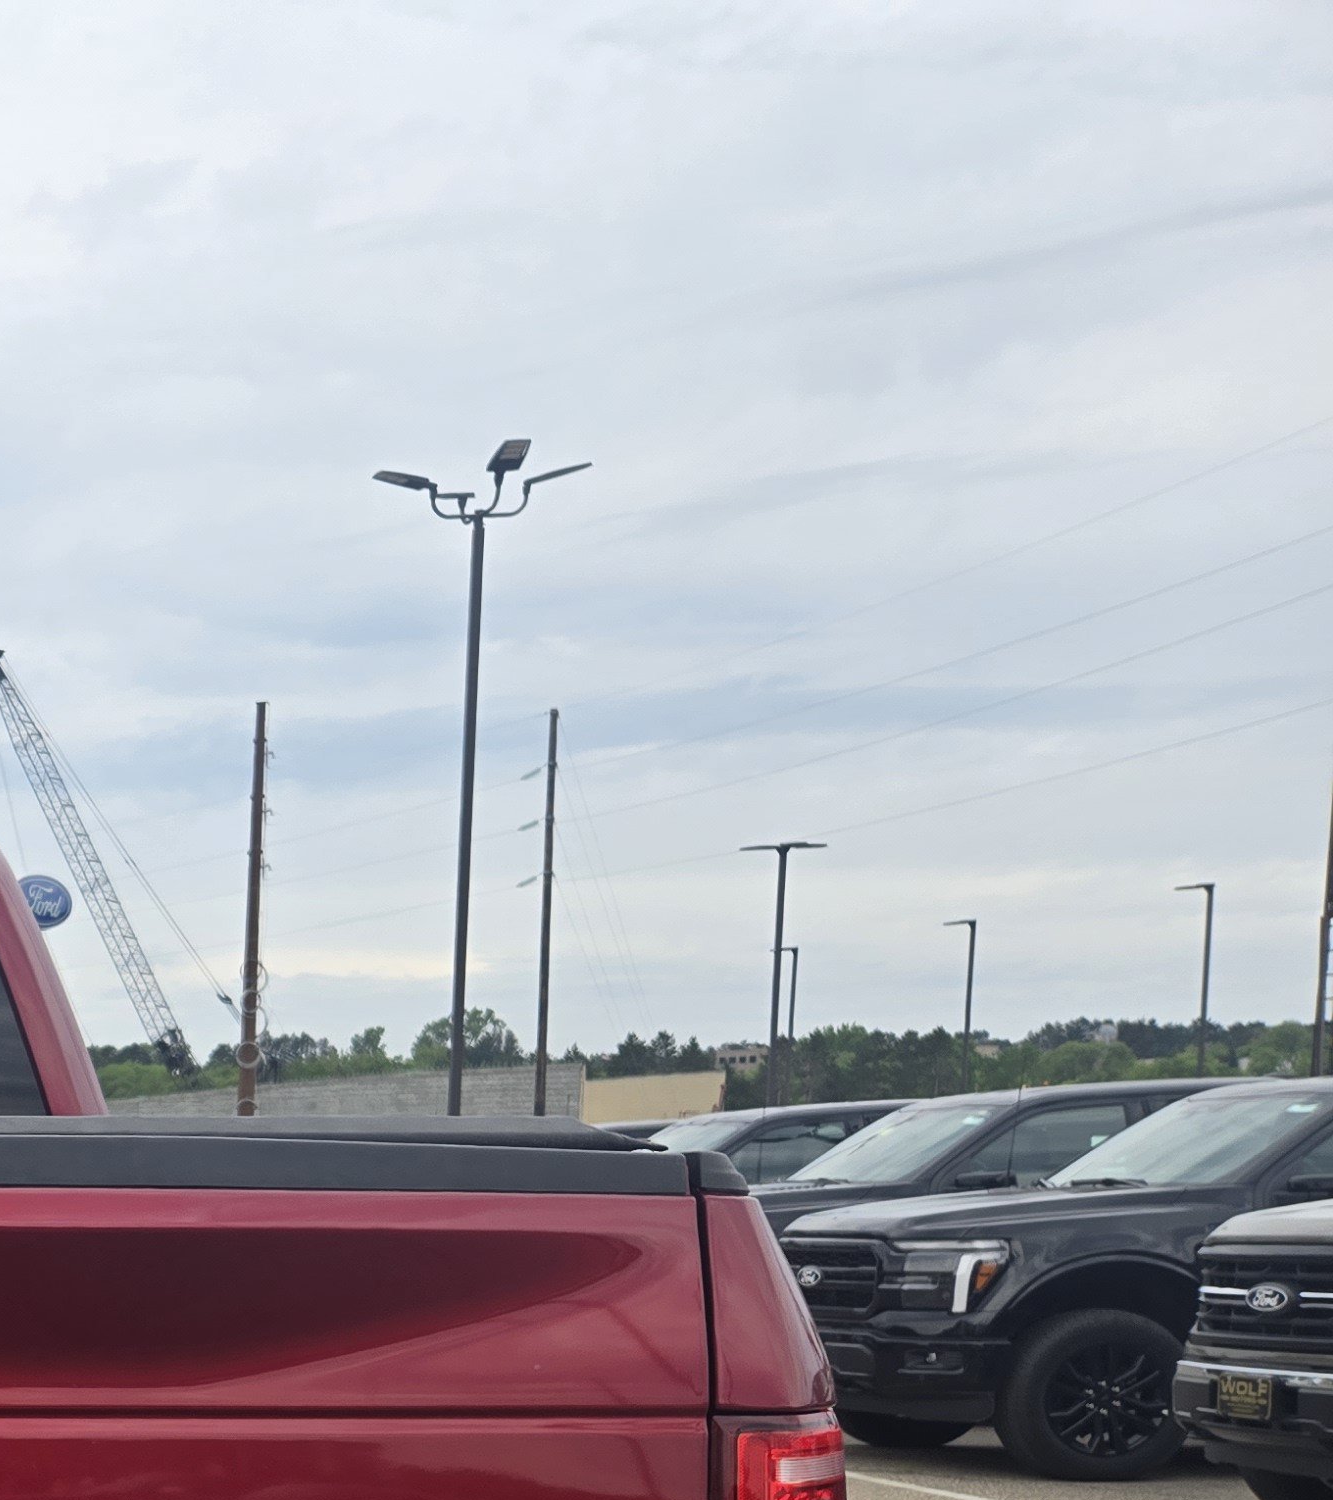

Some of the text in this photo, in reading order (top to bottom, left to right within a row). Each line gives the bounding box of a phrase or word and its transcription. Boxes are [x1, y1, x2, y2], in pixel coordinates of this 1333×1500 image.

[28, 884, 62, 918] Ford
[1252, 1288, 1280, 1307] Ford
[1220, 1379, 1268, 1397] WOLF
